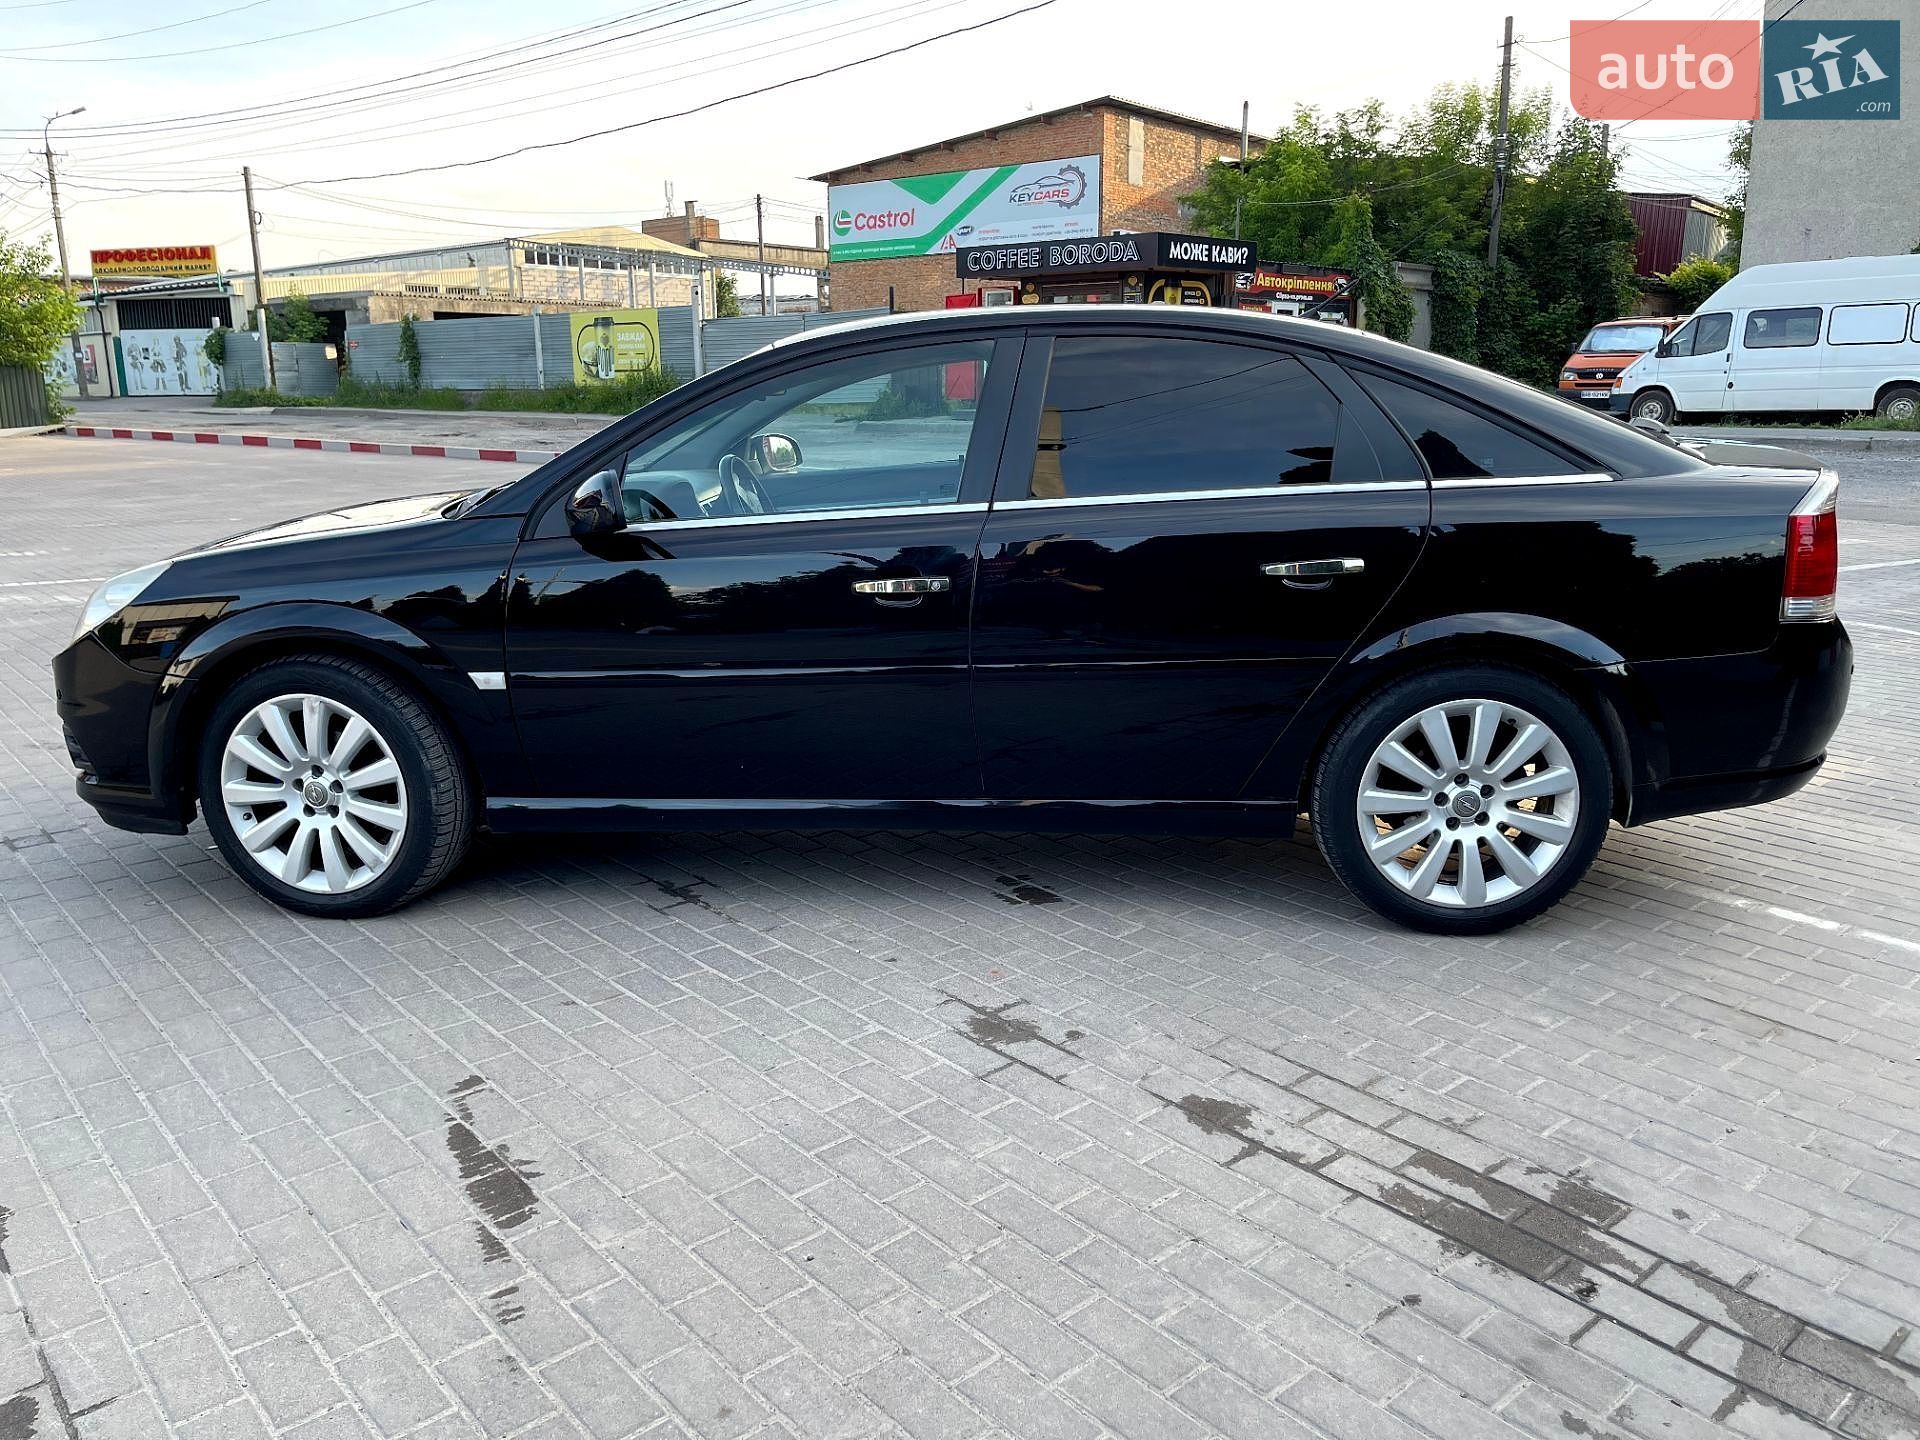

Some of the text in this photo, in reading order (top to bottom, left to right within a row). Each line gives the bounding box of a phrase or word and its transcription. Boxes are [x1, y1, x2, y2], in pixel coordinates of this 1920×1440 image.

[1009, 189, 1070, 204] KEYCARS
[854, 208, 915, 231] Castrol
[92, 247, 213, 264] ПРОФЕСІОНАЛ
[967, 240, 1141, 272] COFFEE BORODA
[1169, 241, 1249, 265] МОЖЕ КАВИ?
[1257, 273, 1333, 291] Автокріплення
